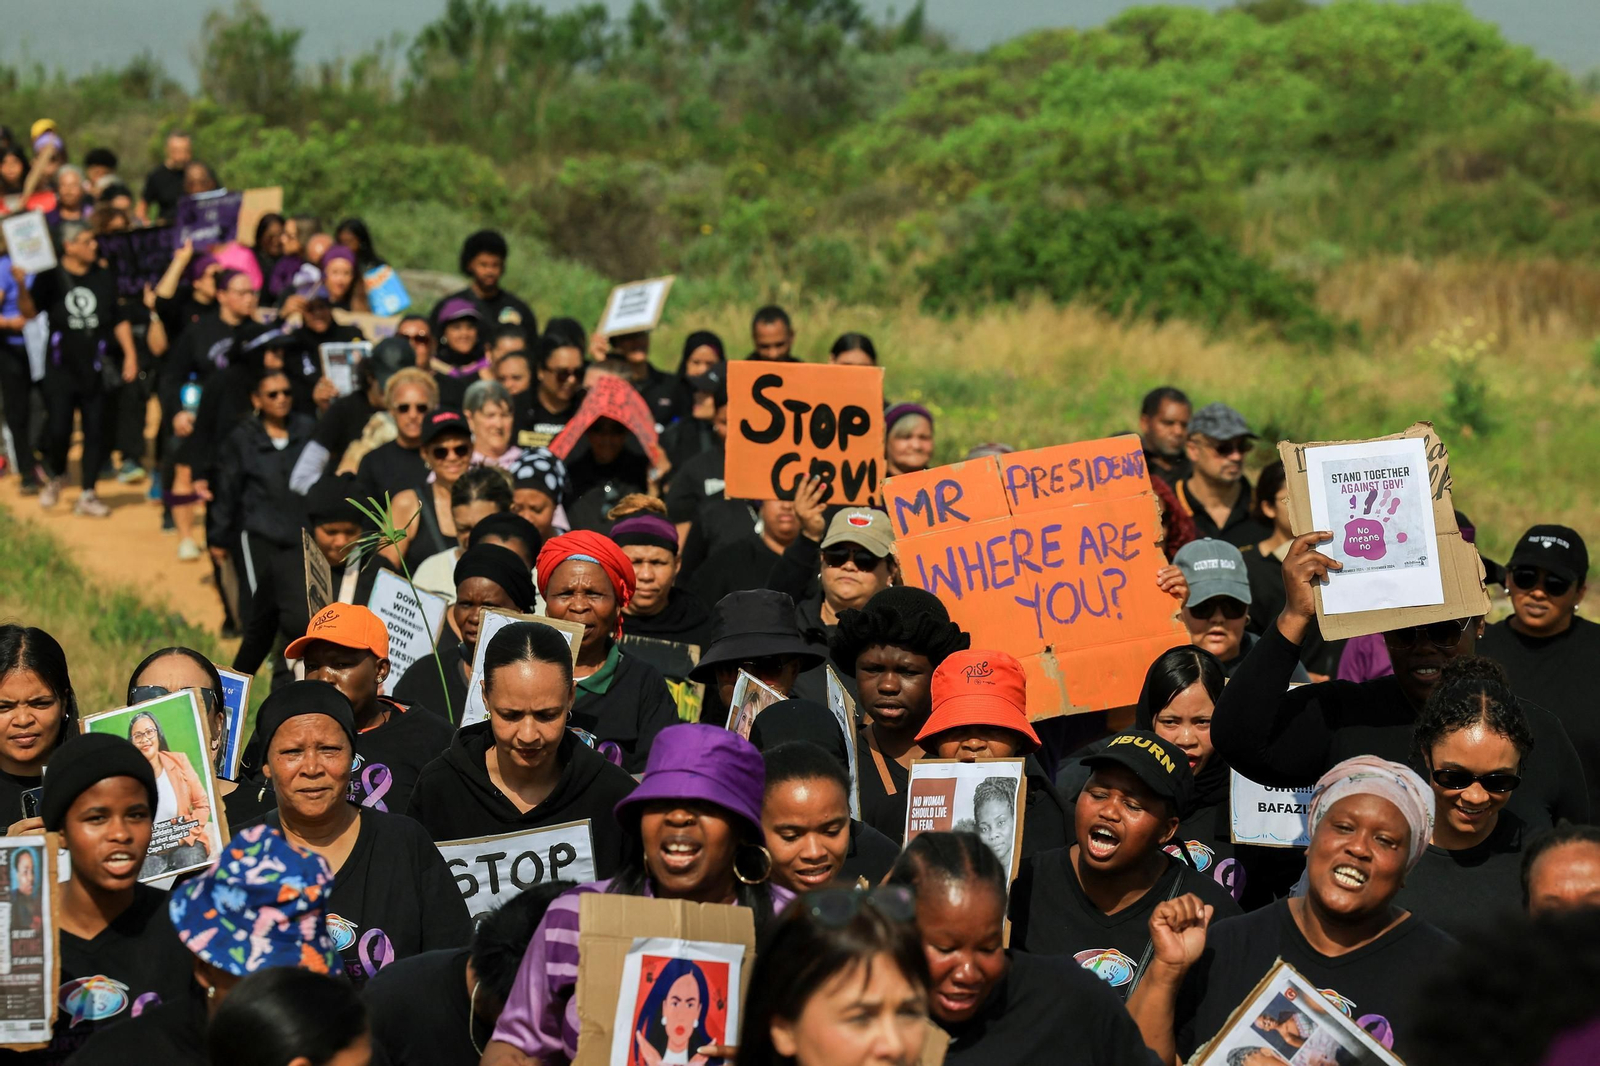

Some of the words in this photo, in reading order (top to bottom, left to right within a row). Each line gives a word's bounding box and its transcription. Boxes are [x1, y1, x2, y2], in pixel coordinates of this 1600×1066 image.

[740, 373, 871, 452] STOP
[770, 452, 877, 507] GBV!
[1331, 471, 1362, 484] STAND
[1363, 466, 1410, 481] TOGETHER
[894, 479, 971, 536] MR
[1005, 449, 1145, 507] PRESIDENT
[1341, 481, 1380, 494] AGAINST
[1382, 478, 1404, 490] GBV!
[1348, 533, 1380, 544] means
[1359, 543, 1372, 551] no
[915, 523, 1065, 601] WHERE
[1078, 521, 1143, 566] ARE
[396, 591, 423, 609] DOWN
[1013, 567, 1128, 640] YOU?
[393, 601, 416, 620] WITH
[386, 621, 414, 640] DOWN
[912, 796, 922, 807] NO
[922, 795, 946, 807] WOMAN
[911, 807, 935, 819] SHOULD
[934, 806, 948, 818] LIVE
[911, 820, 919, 831] IN
[918, 819, 936, 831] FEAR.
[162, 841, 179, 850] Town
[446, 842, 577, 899] STOP
